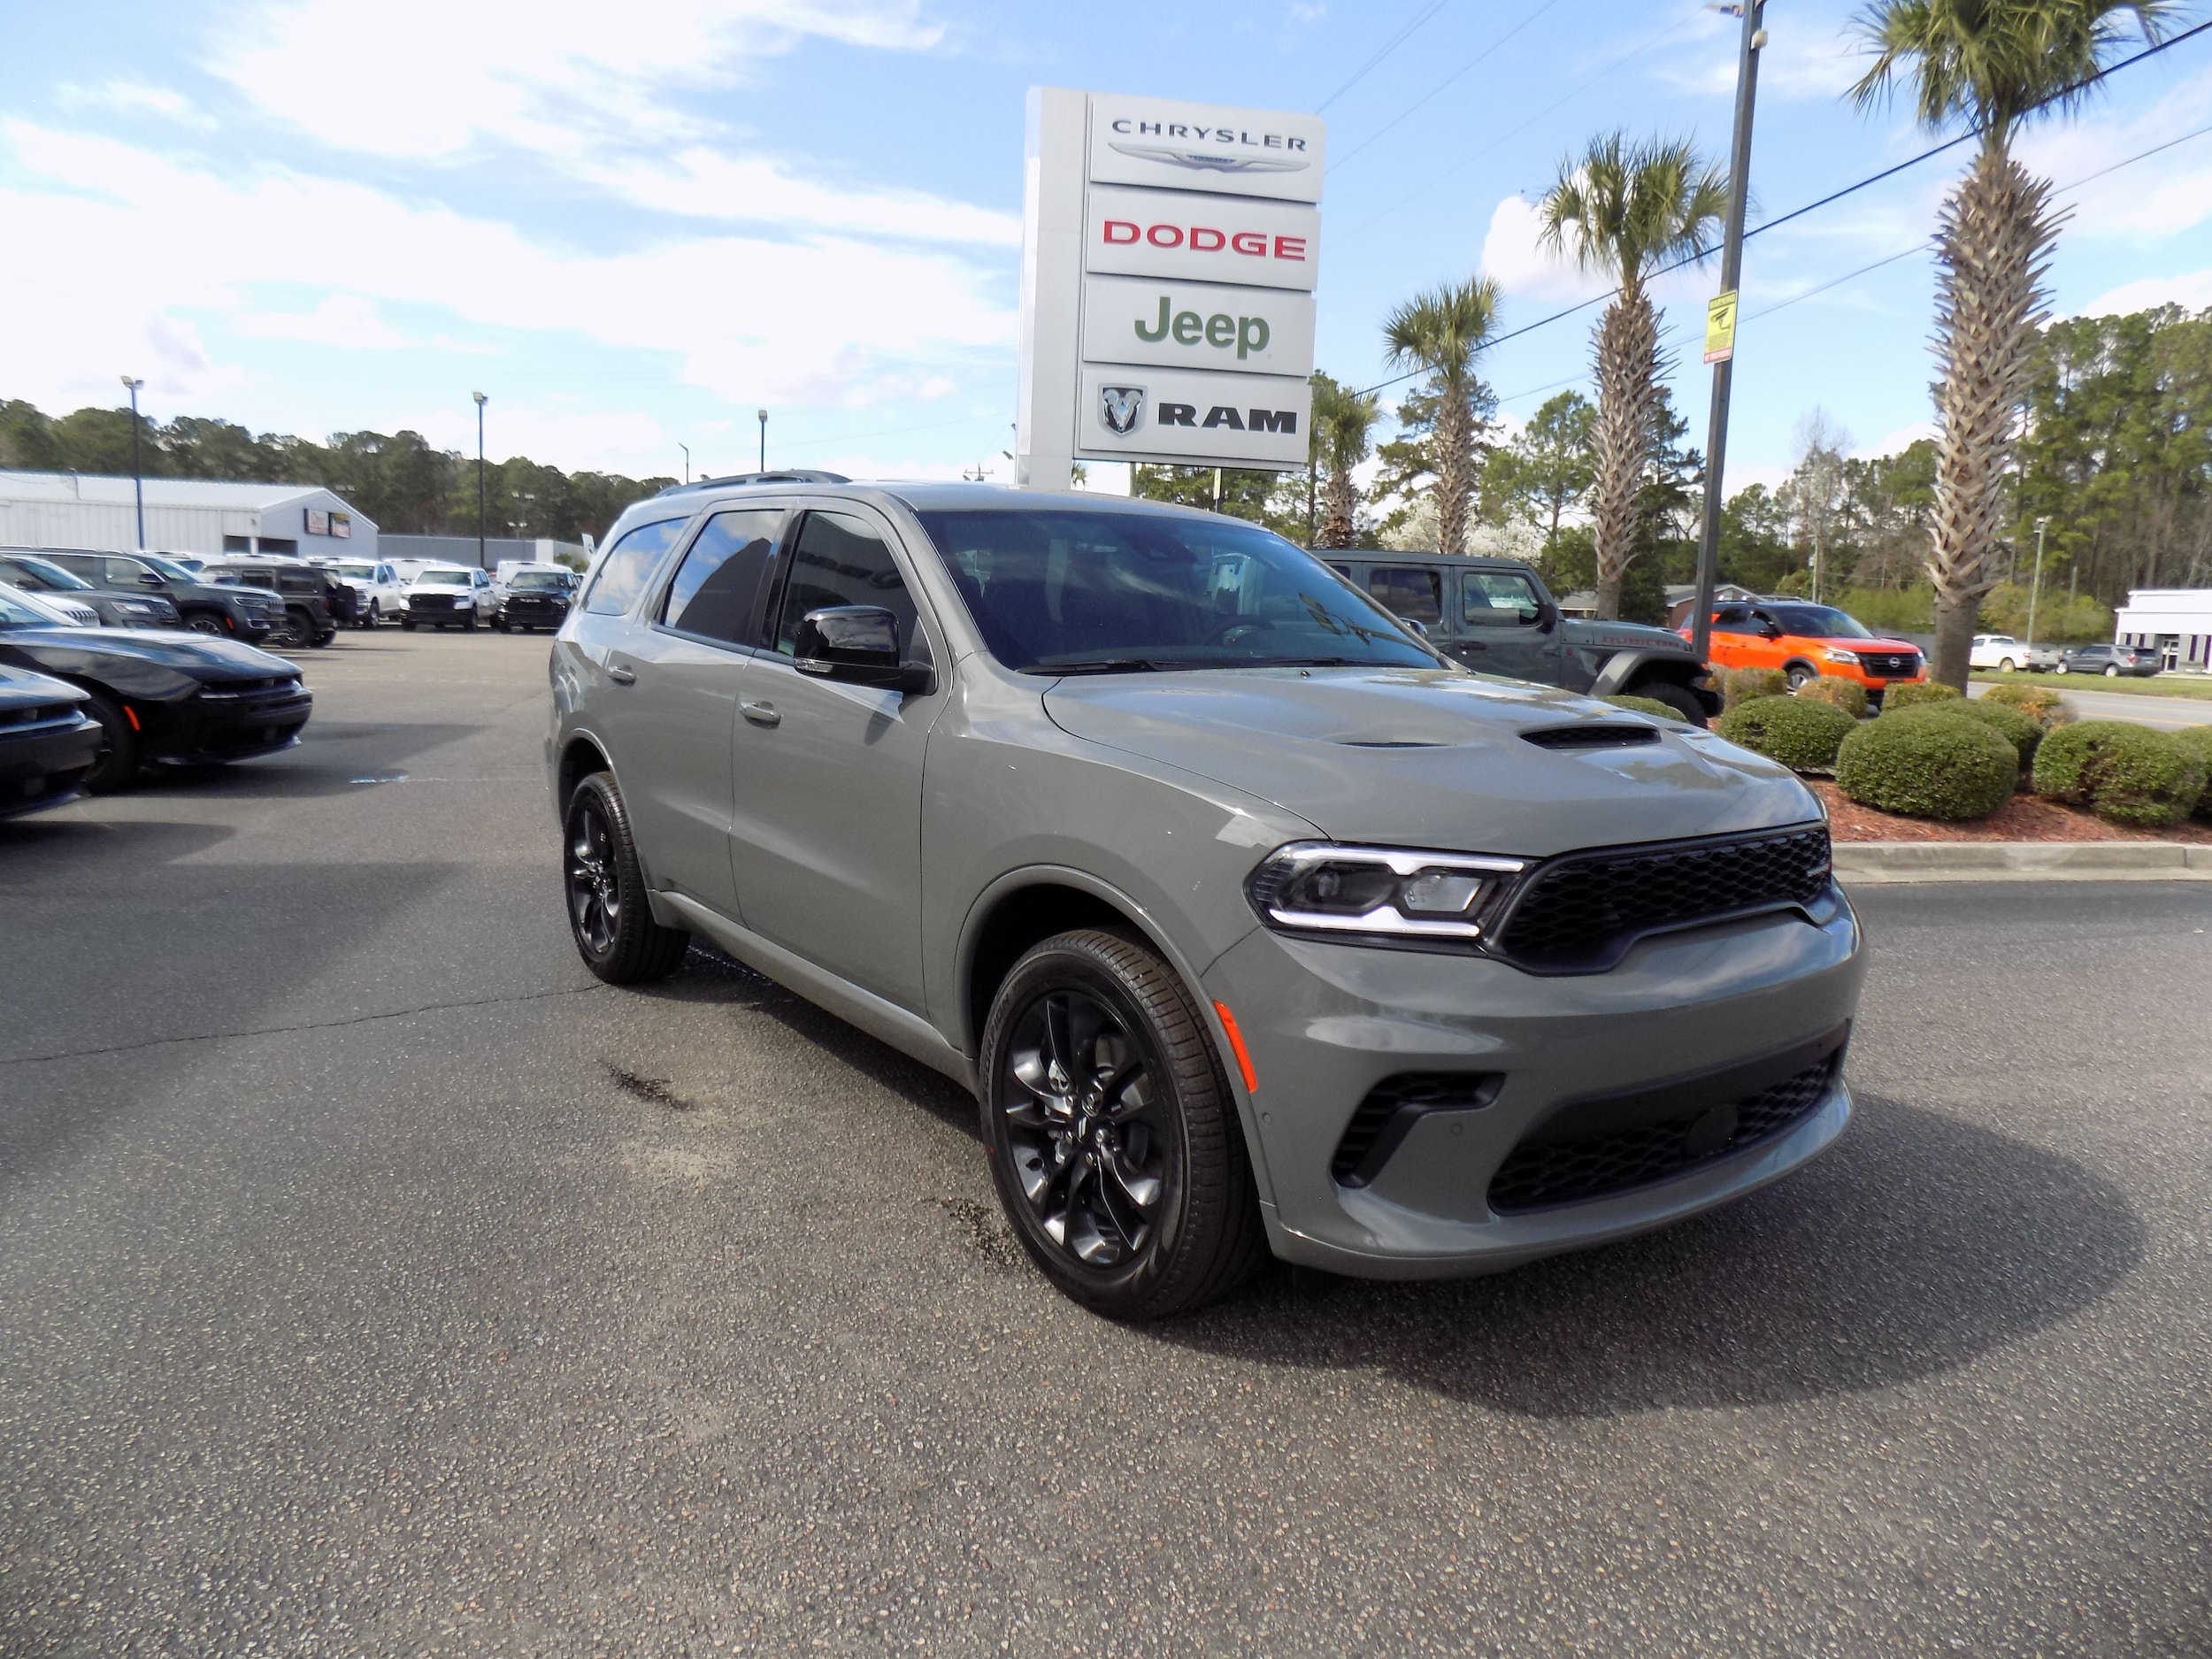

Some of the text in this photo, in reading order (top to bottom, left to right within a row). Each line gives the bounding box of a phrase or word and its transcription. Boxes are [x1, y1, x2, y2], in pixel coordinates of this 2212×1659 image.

[1112, 119, 1306, 151] CHRYSLER
[1103, 220, 1306, 262] DODGE
[1134, 296, 1270, 360] Jeep
[1158, 403, 1297, 434] RAM
[1603, 636, 1679, 648] RUBICON
